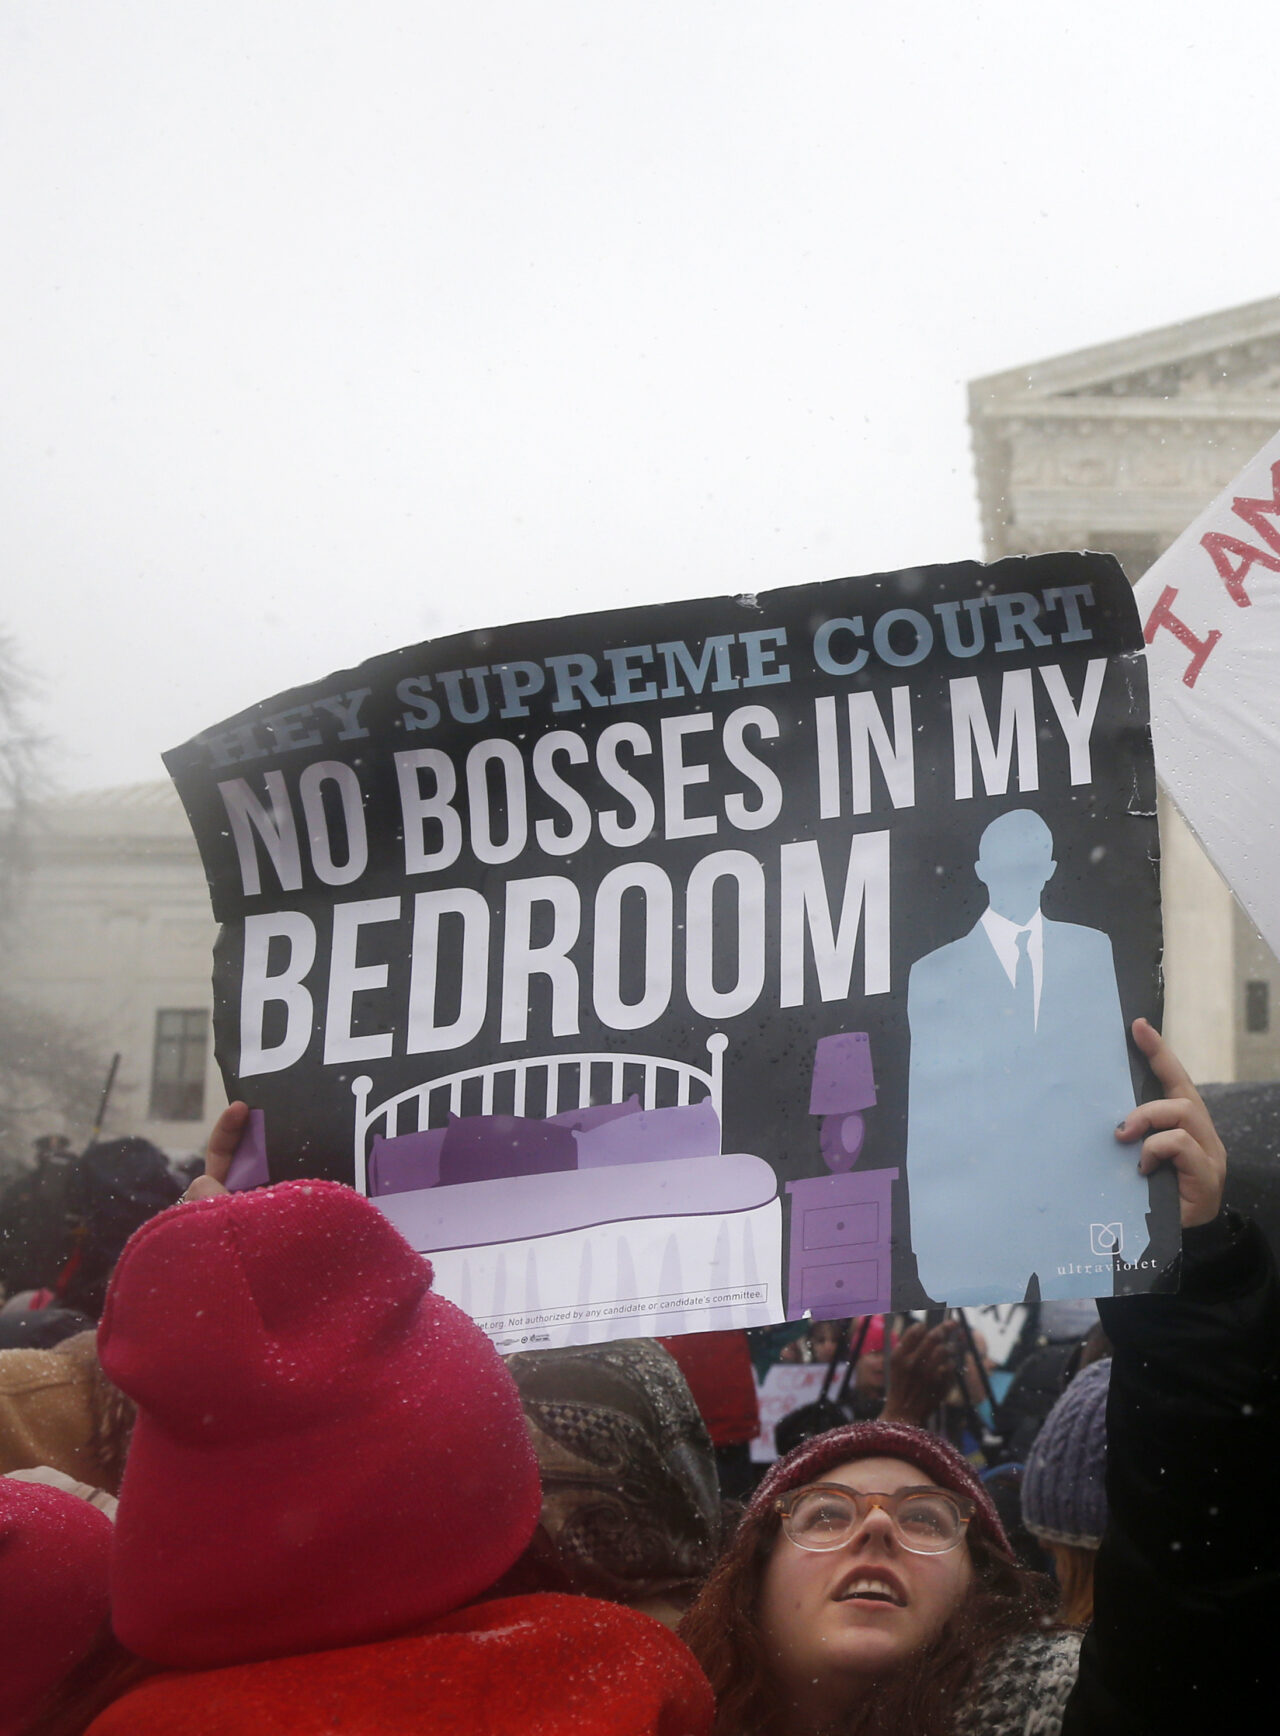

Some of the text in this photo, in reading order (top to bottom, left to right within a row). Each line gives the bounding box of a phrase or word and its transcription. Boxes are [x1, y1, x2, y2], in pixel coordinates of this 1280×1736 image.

[205, 584, 1096, 769] HEY SUPREME COURT
[1143, 585, 1222, 688] I
[217, 658, 1108, 896] NO BOSSES IN MY
[239, 830, 891, 1078] BEDROOM
[508, 1317, 523, 1327] Not
[525, 1311, 571, 1325] authorized
[573, 1310, 583, 1319] by
[585, 1308, 602, 1318] any
[603, 1303, 646, 1316] candidate
[648, 1302, 658, 1310] or
[660, 1295, 711, 1309] candidate's
[1056, 1258, 1158, 1275] ultraviolet
